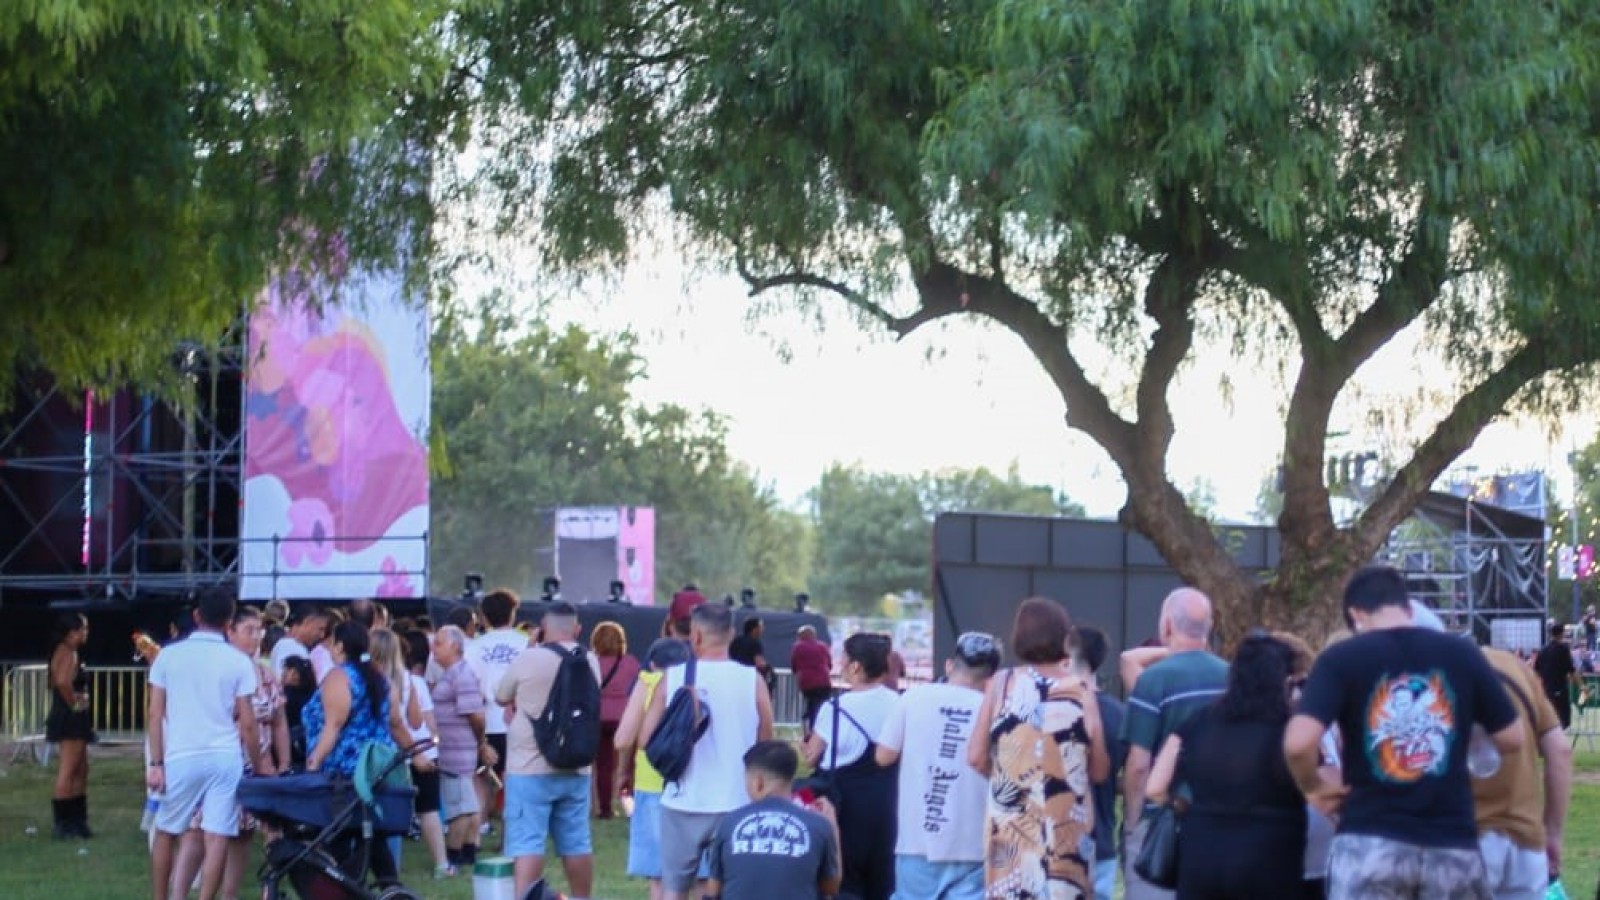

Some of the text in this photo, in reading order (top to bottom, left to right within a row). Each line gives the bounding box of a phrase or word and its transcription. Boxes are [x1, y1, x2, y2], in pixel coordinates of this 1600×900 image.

[923, 706, 972, 833] Palm Angels
[732, 839, 805, 857] REEF
